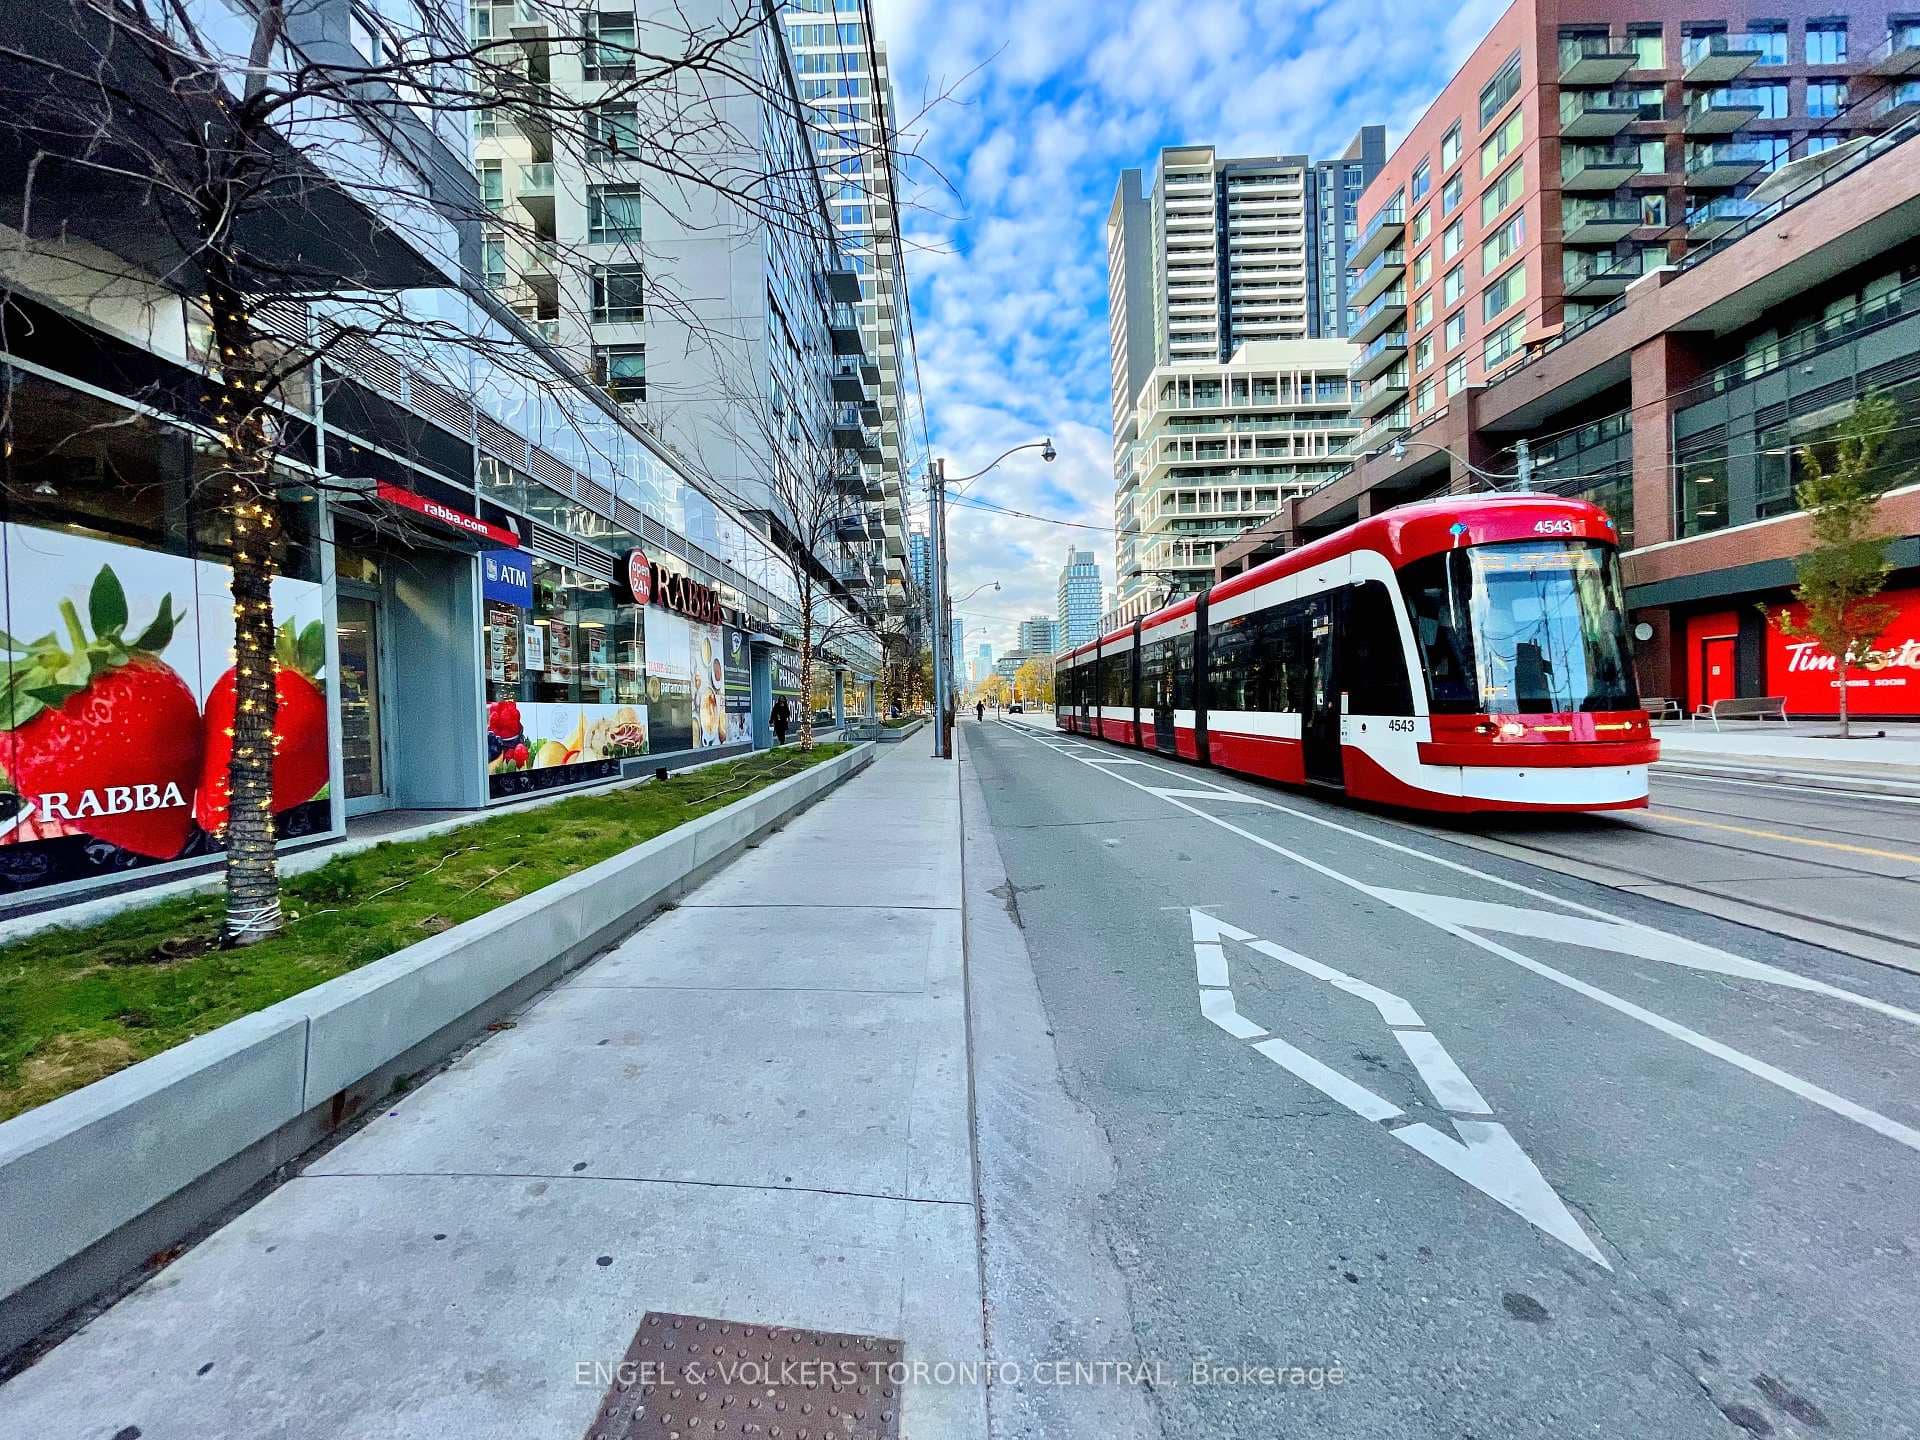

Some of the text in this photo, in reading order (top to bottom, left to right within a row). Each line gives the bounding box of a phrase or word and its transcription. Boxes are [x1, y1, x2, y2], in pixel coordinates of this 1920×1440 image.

[424, 503, 488, 535] rabba.com
[1534, 519, 1573, 534] 4543
[500, 565, 527, 588] ATM
[632, 561, 650, 577] open
[633, 577, 649, 596] 24h
[654, 562, 728, 626] RABBA
[1785, 641, 1836, 673] Tim
[1388, 719, 1415, 733] 4543
[38, 781, 187, 823] RABBA
